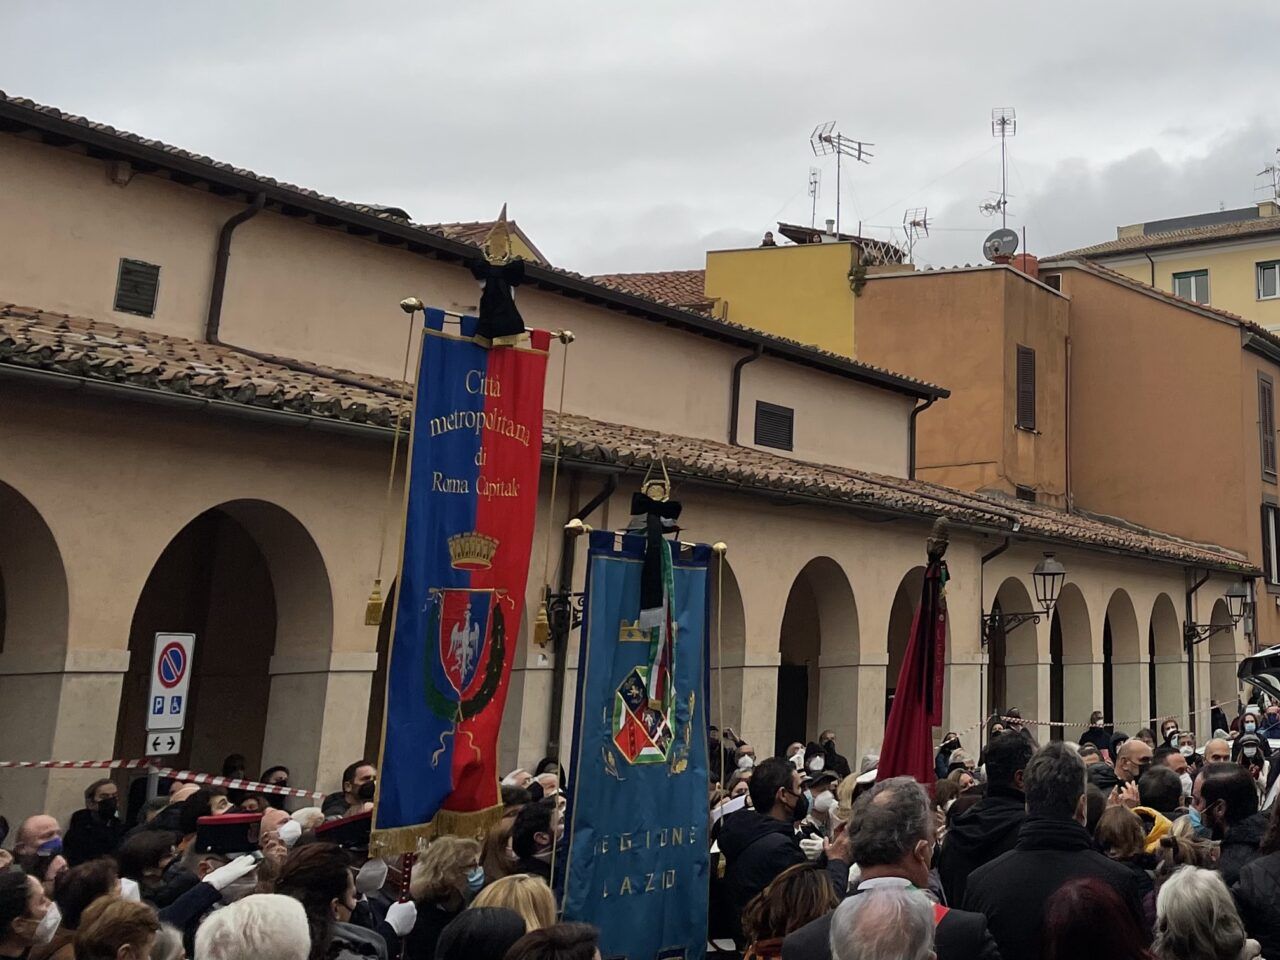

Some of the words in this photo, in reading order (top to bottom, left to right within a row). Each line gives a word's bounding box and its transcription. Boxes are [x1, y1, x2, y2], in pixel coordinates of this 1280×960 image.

[466, 370, 501, 397] Città
[430, 407, 530, 447] metropolitana
[474, 447, 487, 466] di
[432, 471, 469, 494] Roma
[475, 475, 520, 501] Capitale
[603, 869, 675, 898] LAZIO
